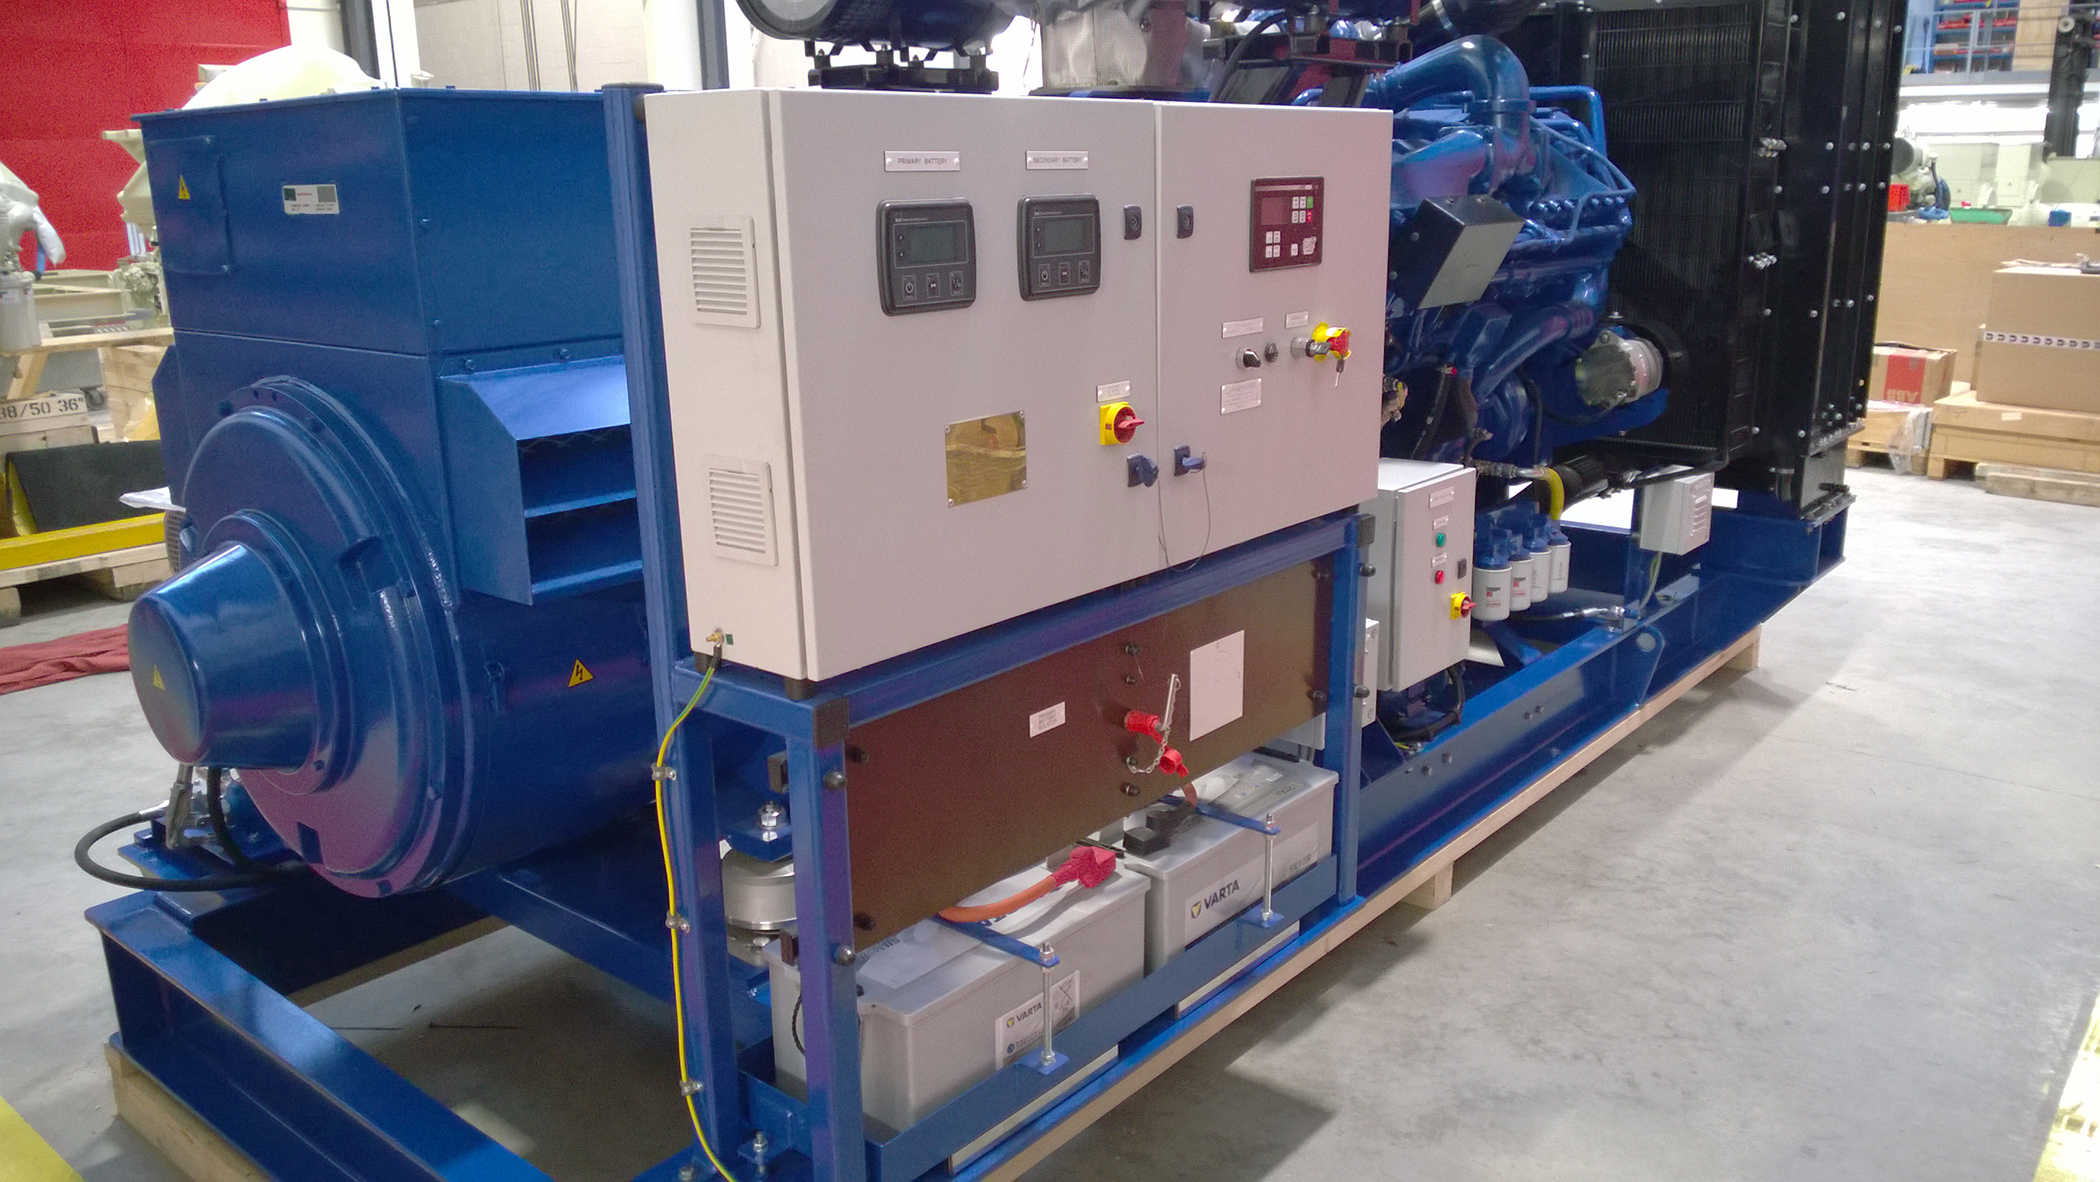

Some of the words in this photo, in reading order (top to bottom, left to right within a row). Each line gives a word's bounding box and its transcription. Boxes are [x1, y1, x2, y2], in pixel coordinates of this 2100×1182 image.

[897, 157, 921, 165] PRIMARY
[924, 157, 948, 165] BATTERY
[1033, 156, 1060, 164] SECONDARY
[1062, 156, 1083, 164] BATTERY
[1886, 389, 1919, 403] ABB
[1203, 879, 1240, 910] VARTA
[1016, 1002, 1042, 1022] VARTA
